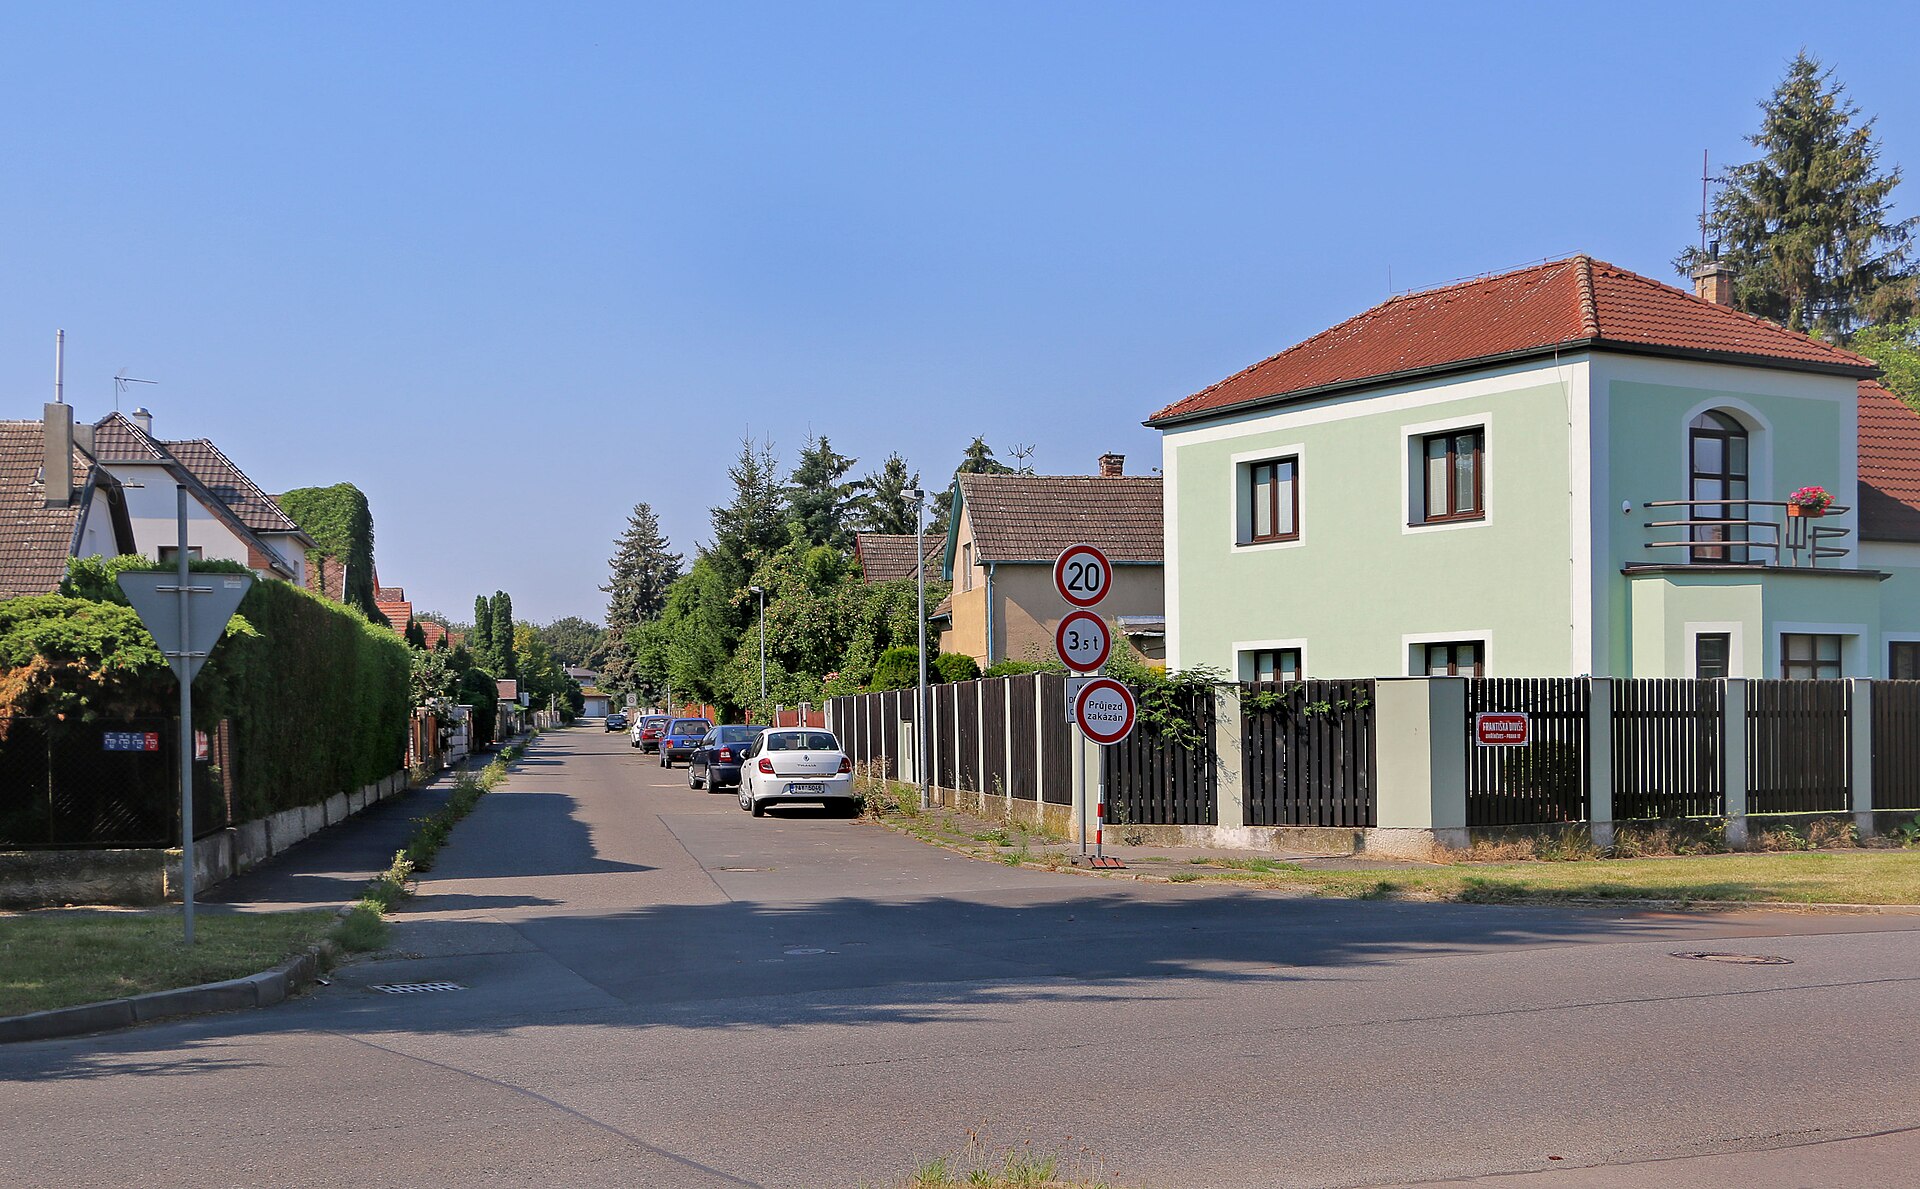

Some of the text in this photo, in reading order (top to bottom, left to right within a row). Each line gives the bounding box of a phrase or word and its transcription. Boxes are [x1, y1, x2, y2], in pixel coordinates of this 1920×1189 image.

[1068, 562, 1099, 591] 20
[1088, 701, 1123, 711] Průjezd
[1087, 712, 1123, 721] zakázán
[1483, 720, 1508, 731] FRANTIŠKA
